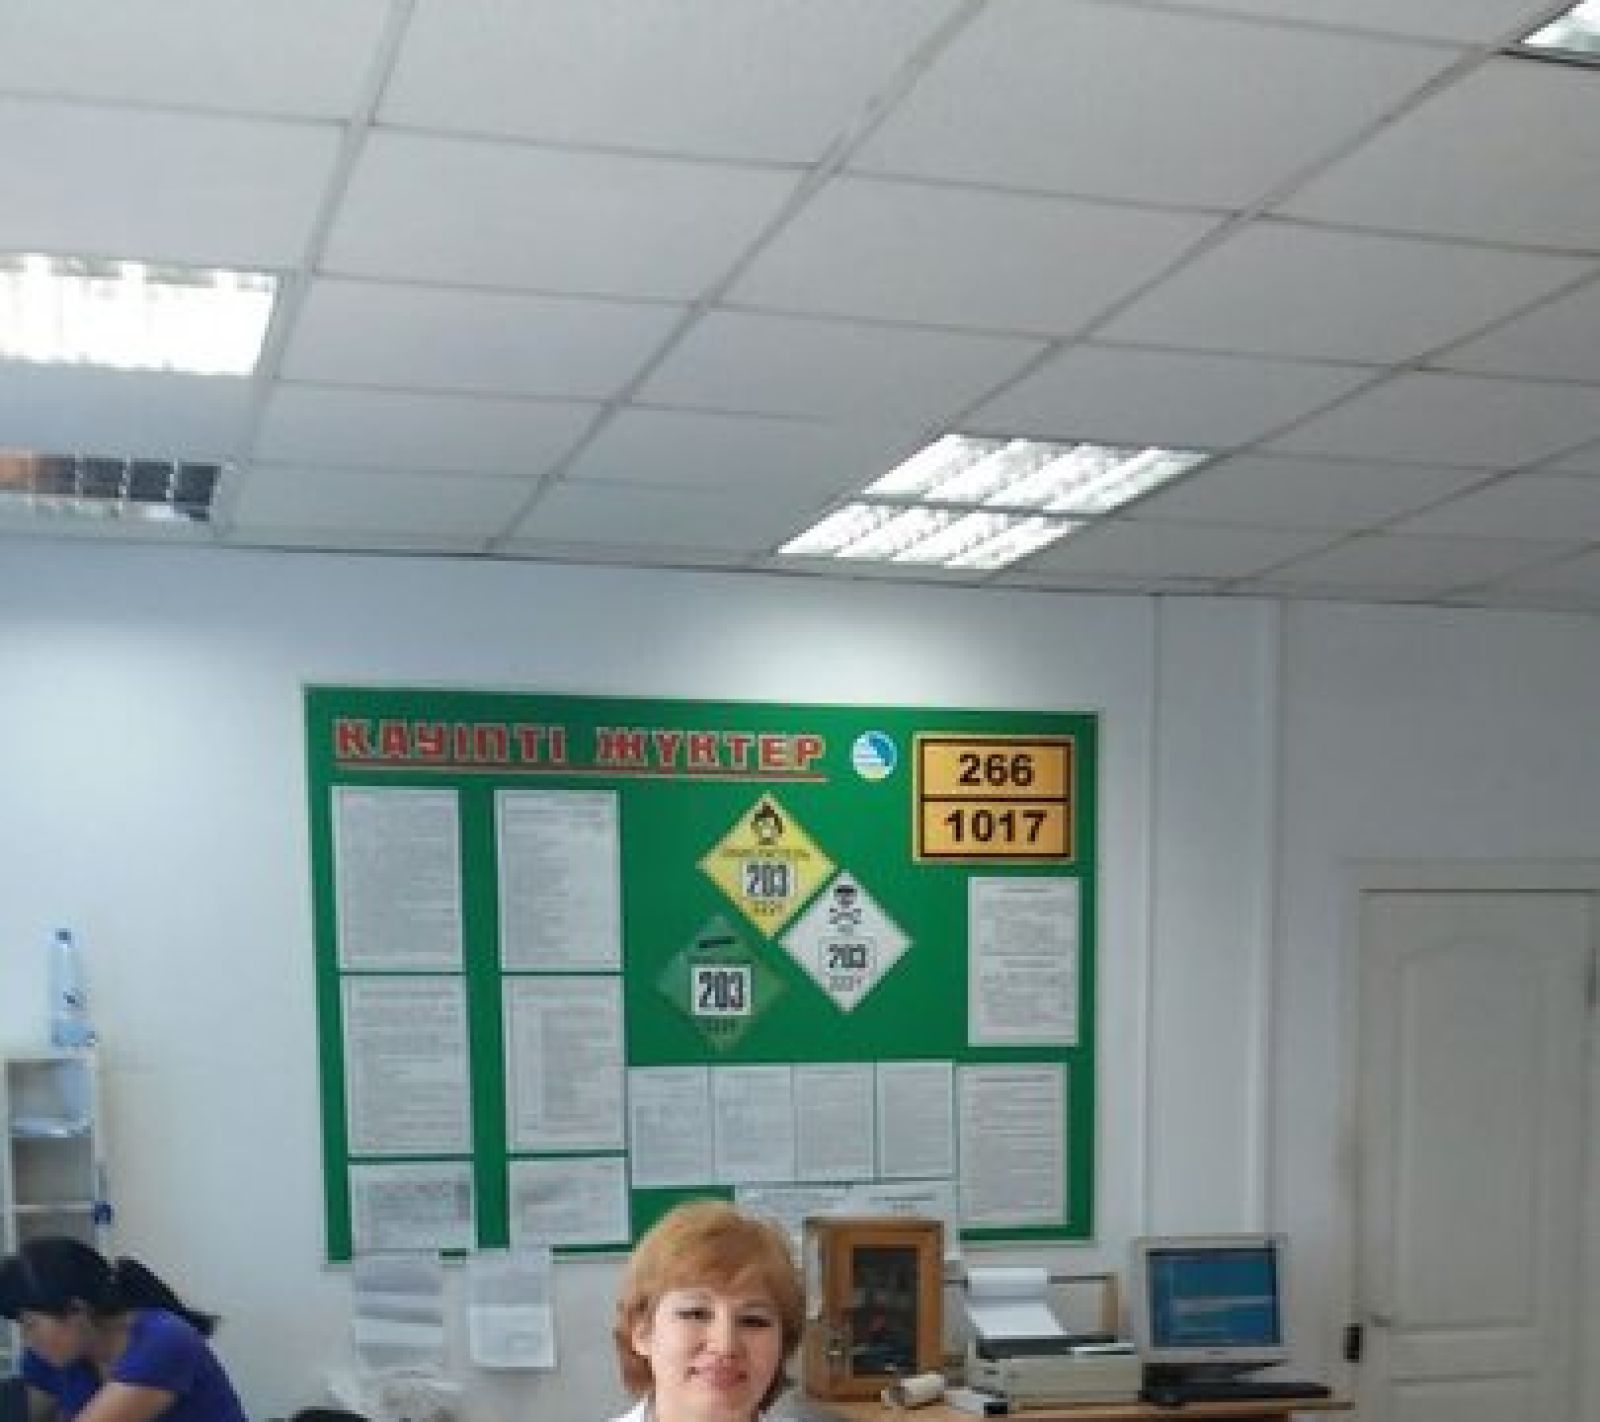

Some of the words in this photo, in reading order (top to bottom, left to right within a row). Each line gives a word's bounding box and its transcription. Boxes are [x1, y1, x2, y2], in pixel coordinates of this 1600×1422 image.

[958, 753, 1034, 787] 266
[944, 809, 1047, 844] 1017
[746, 862, 789, 898] 203
[698, 971, 744, 1011] 203
